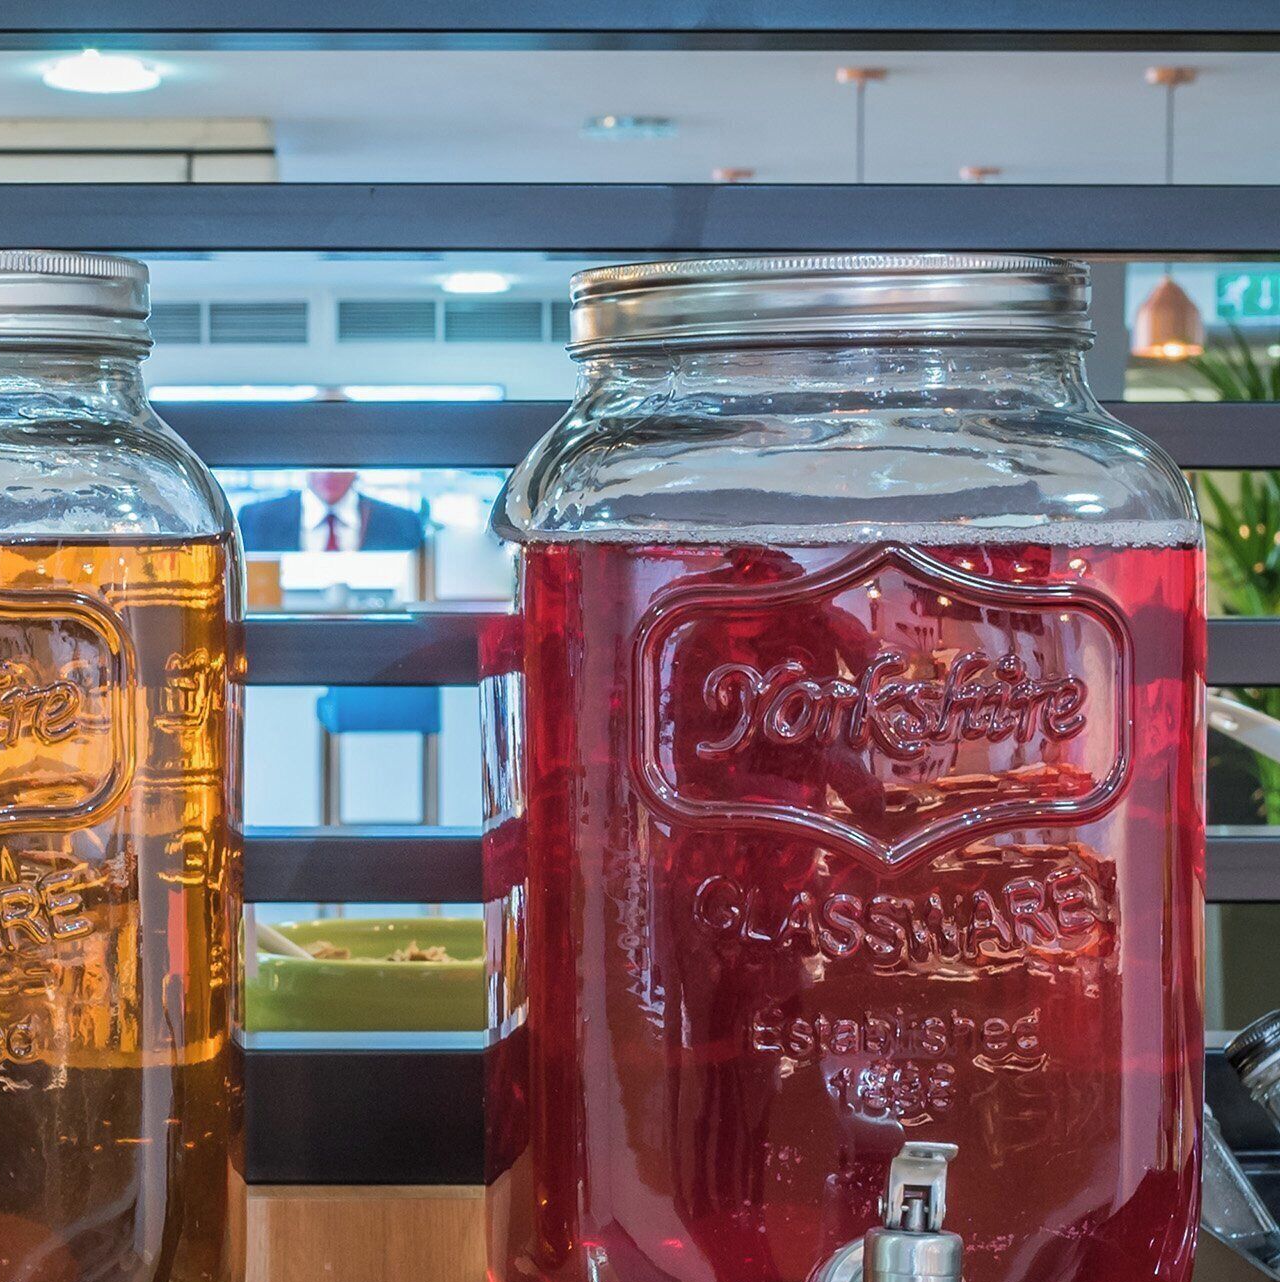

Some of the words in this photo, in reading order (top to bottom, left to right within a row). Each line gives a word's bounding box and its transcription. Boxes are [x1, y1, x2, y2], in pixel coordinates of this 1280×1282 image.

[697, 652, 1088, 761] Yorkshire
[694, 866, 1097, 961] GLASSWARE
[752, 1008, 1041, 1056] Established
